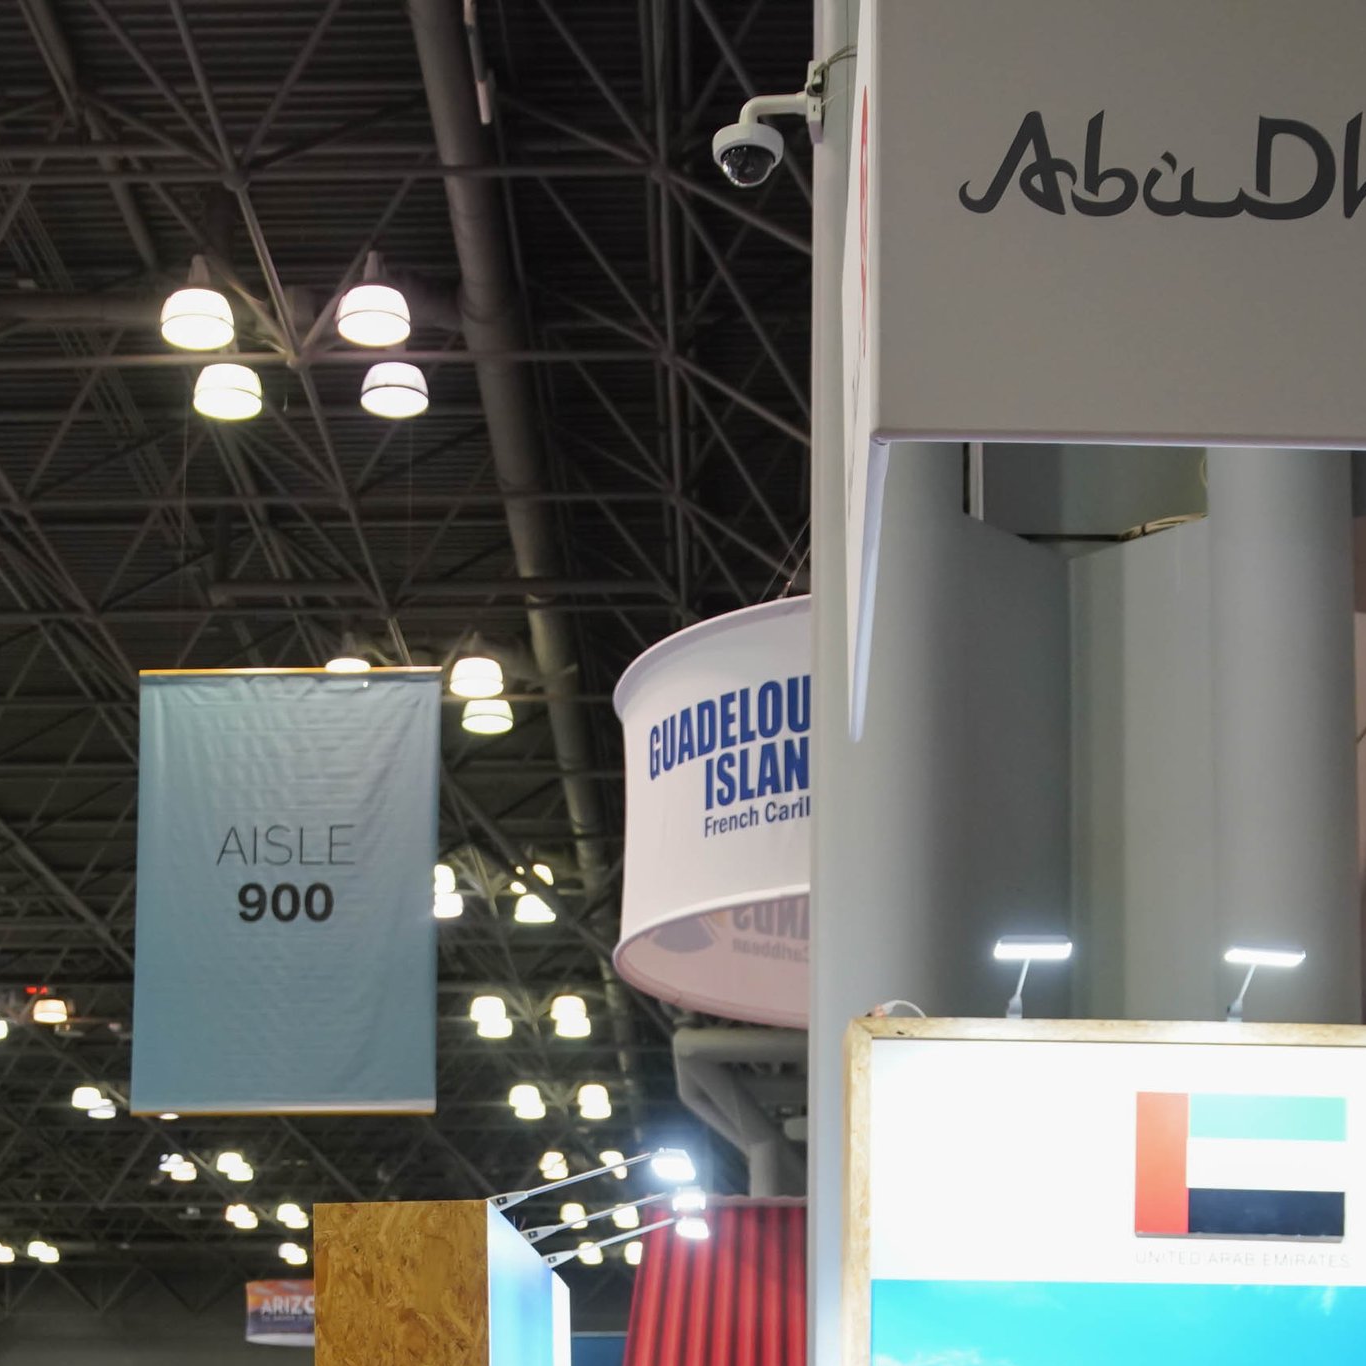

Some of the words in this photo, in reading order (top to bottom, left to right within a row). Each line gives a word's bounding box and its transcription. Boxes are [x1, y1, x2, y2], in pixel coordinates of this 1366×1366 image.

[649, 675, 811, 781] GUADELOU
[705, 736, 809, 811] ISLAN
[704, 805, 759, 838] French
[216, 824, 356, 866] AISLE
[237, 882, 335, 923] 900
[1135, 1250, 1201, 1265] UNITED
[1208, 1252, 1255, 1266] ARAB
[1262, 1252, 1352, 1269] EMIRATES
